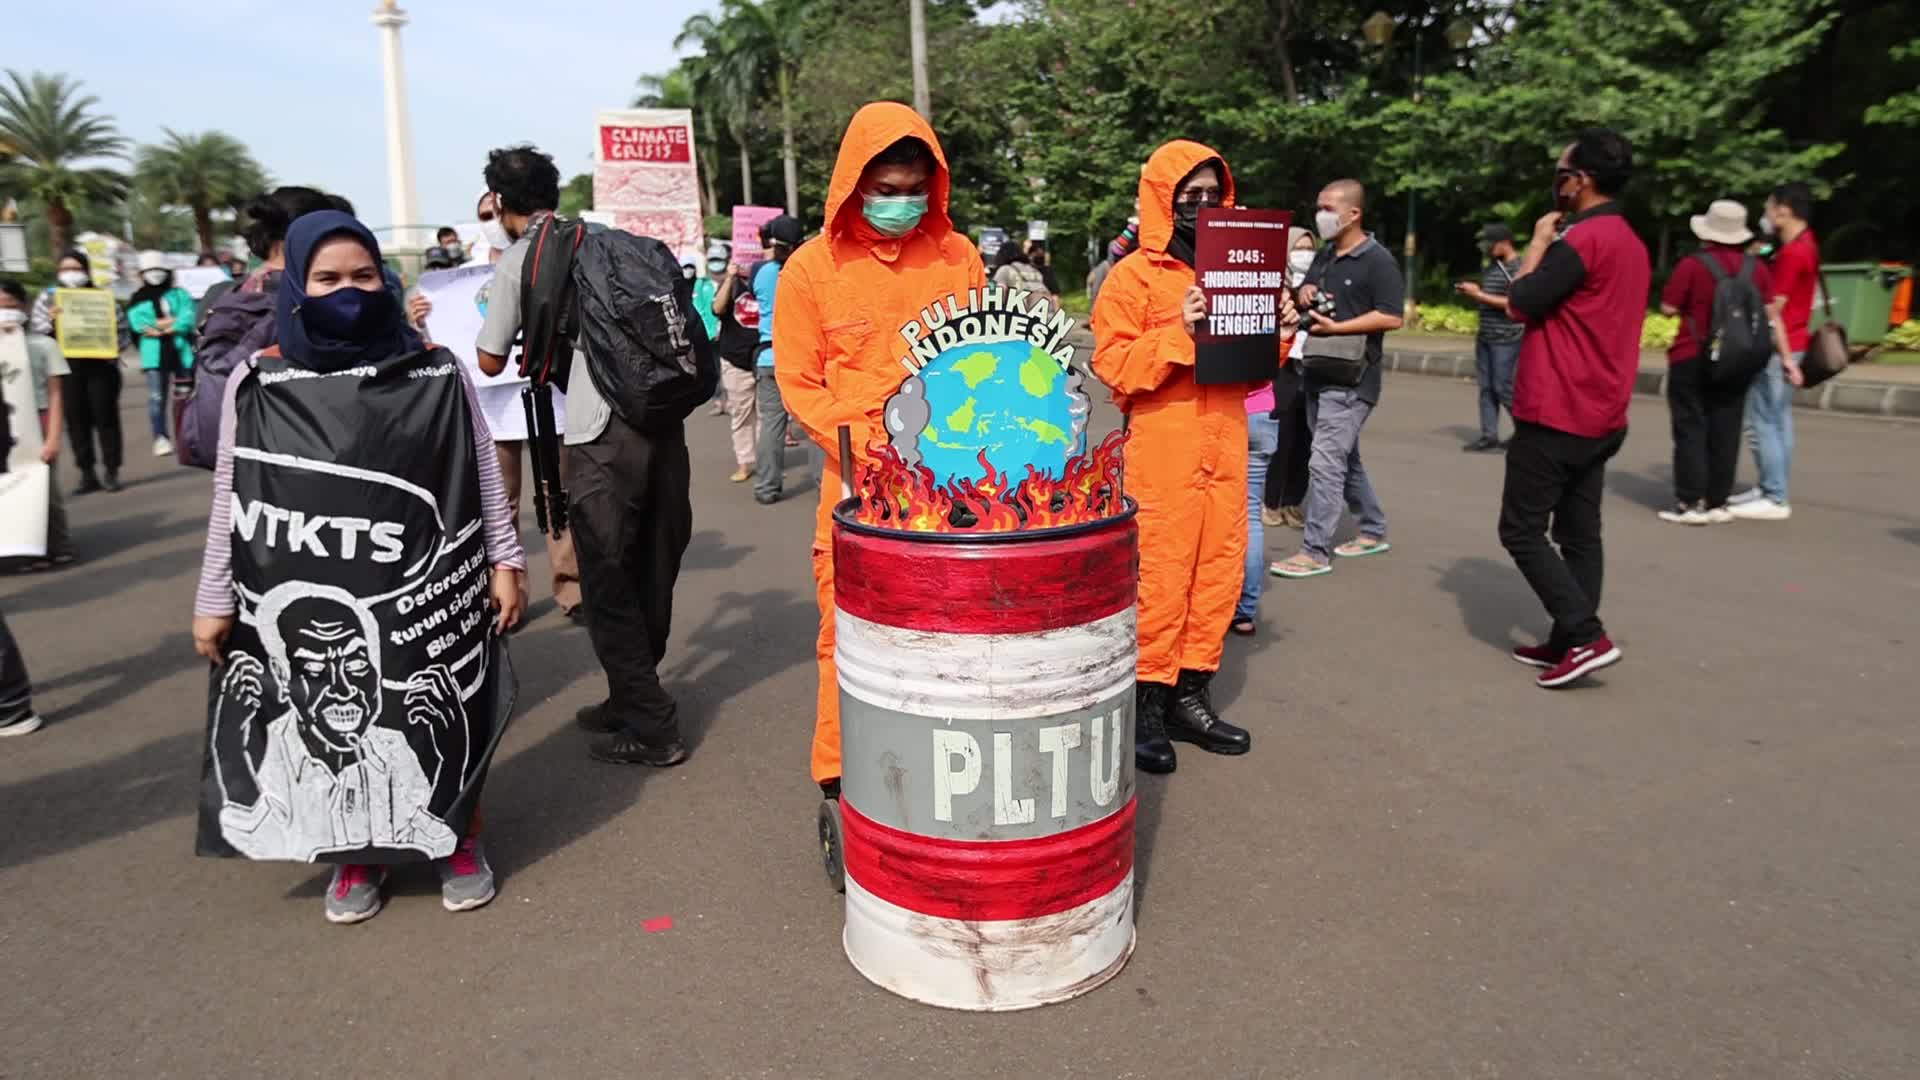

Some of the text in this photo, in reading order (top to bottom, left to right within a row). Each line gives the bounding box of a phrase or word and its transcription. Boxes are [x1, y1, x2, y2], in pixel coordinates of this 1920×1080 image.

[611, 128, 687, 144] CLIMATE
[611, 144, 672, 159] CRISIS
[1228, 249, 1265, 264] 2045:
[1212, 294, 1275, 315] INDONESIA
[900, 287, 1076, 347] PULIHKAN
[1208, 314, 1276, 336] TENGGELAM
[901, 313, 1076, 377] INDONESIA
[390, 608, 449, 646] turun
[933, 707, 1121, 826] PLTU
